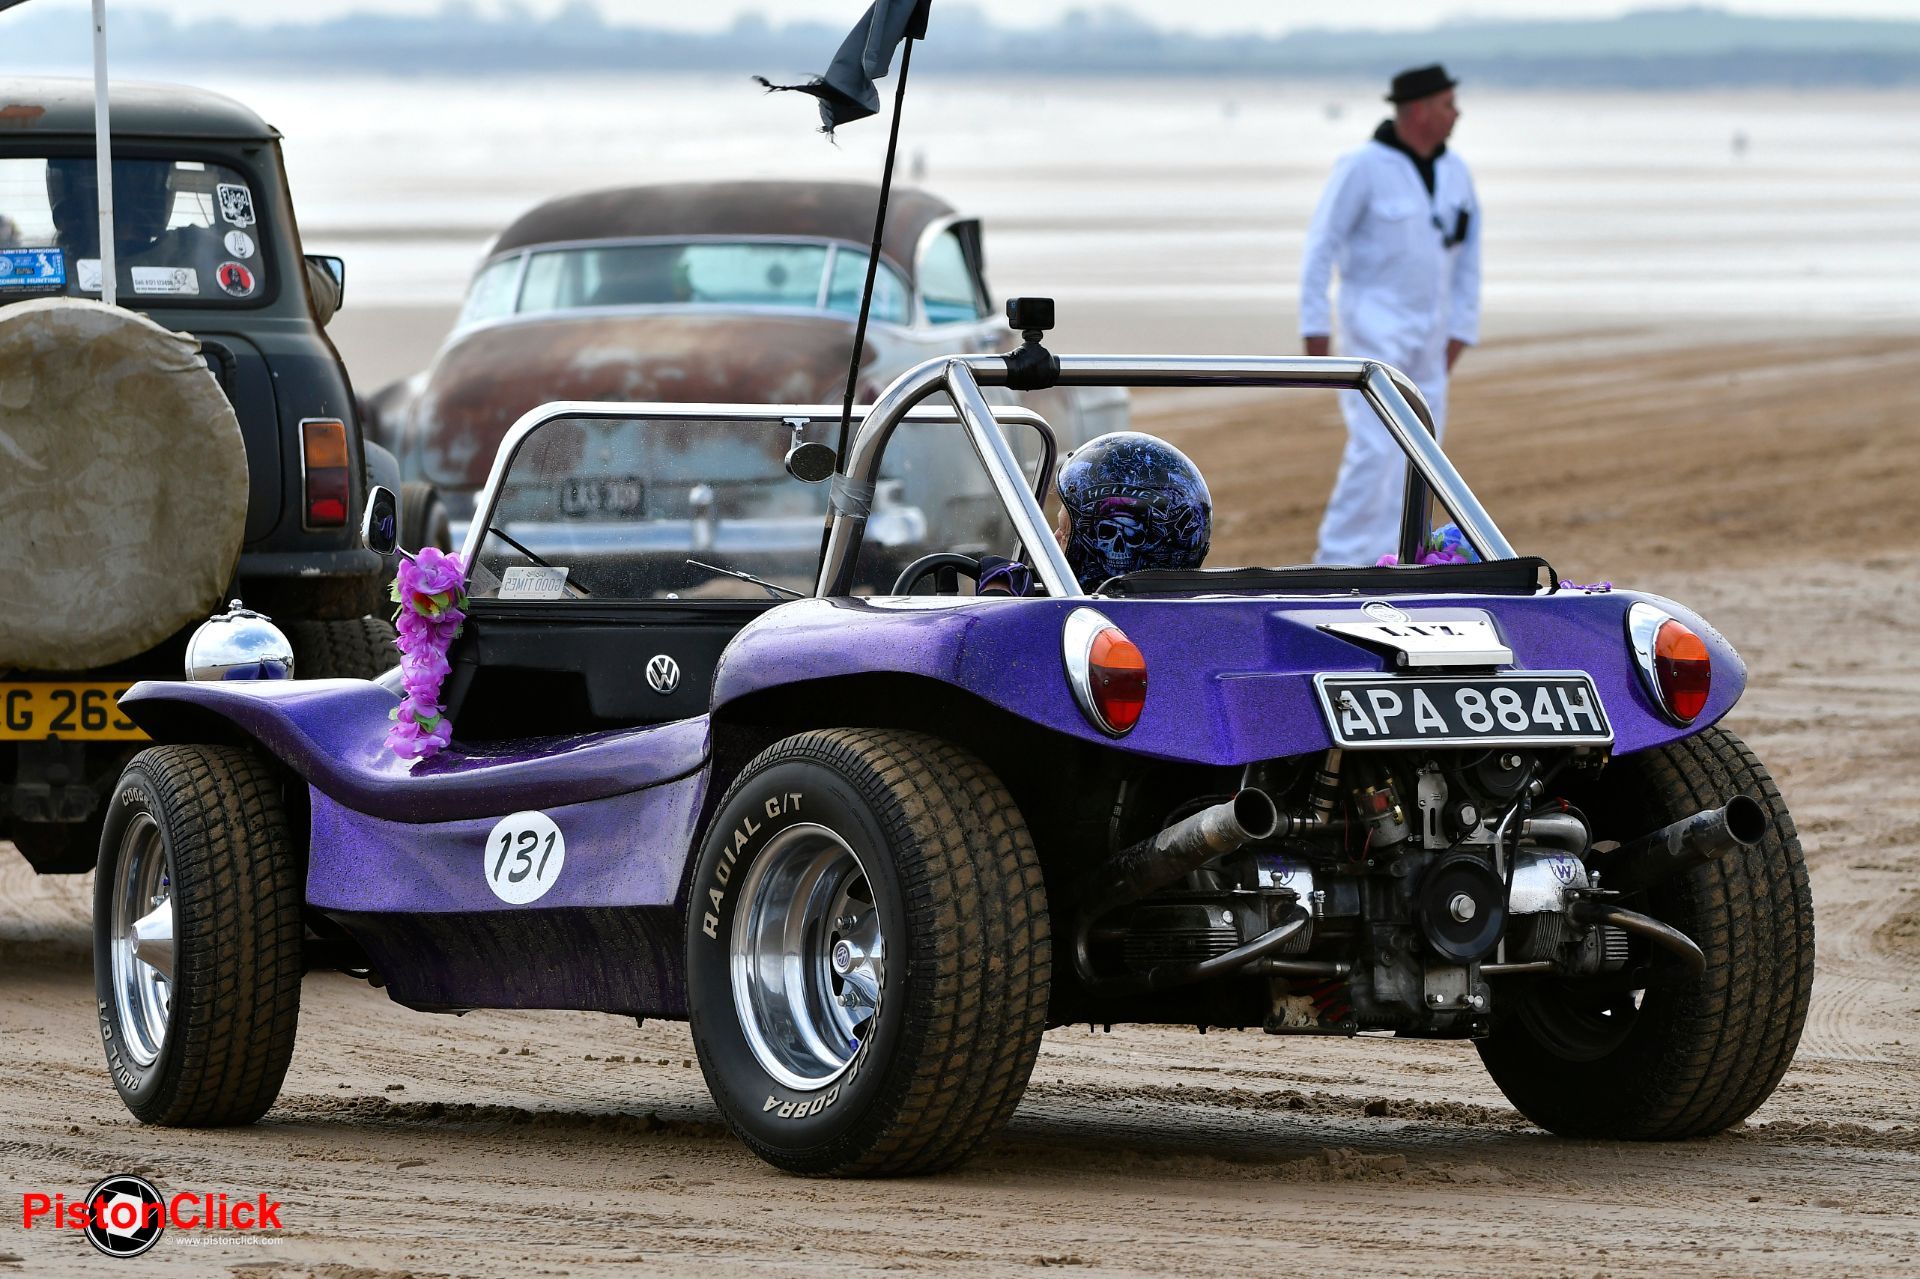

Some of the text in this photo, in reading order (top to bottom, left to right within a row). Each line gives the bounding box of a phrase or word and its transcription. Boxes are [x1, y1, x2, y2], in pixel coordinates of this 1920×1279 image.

[0, 689, 33, 731] G
[493, 829, 556, 883] 131
[702, 792, 803, 940] RADIAL G/T
[110, 1043, 143, 1090] RADIAL
[762, 1083, 842, 1118] COBRA
